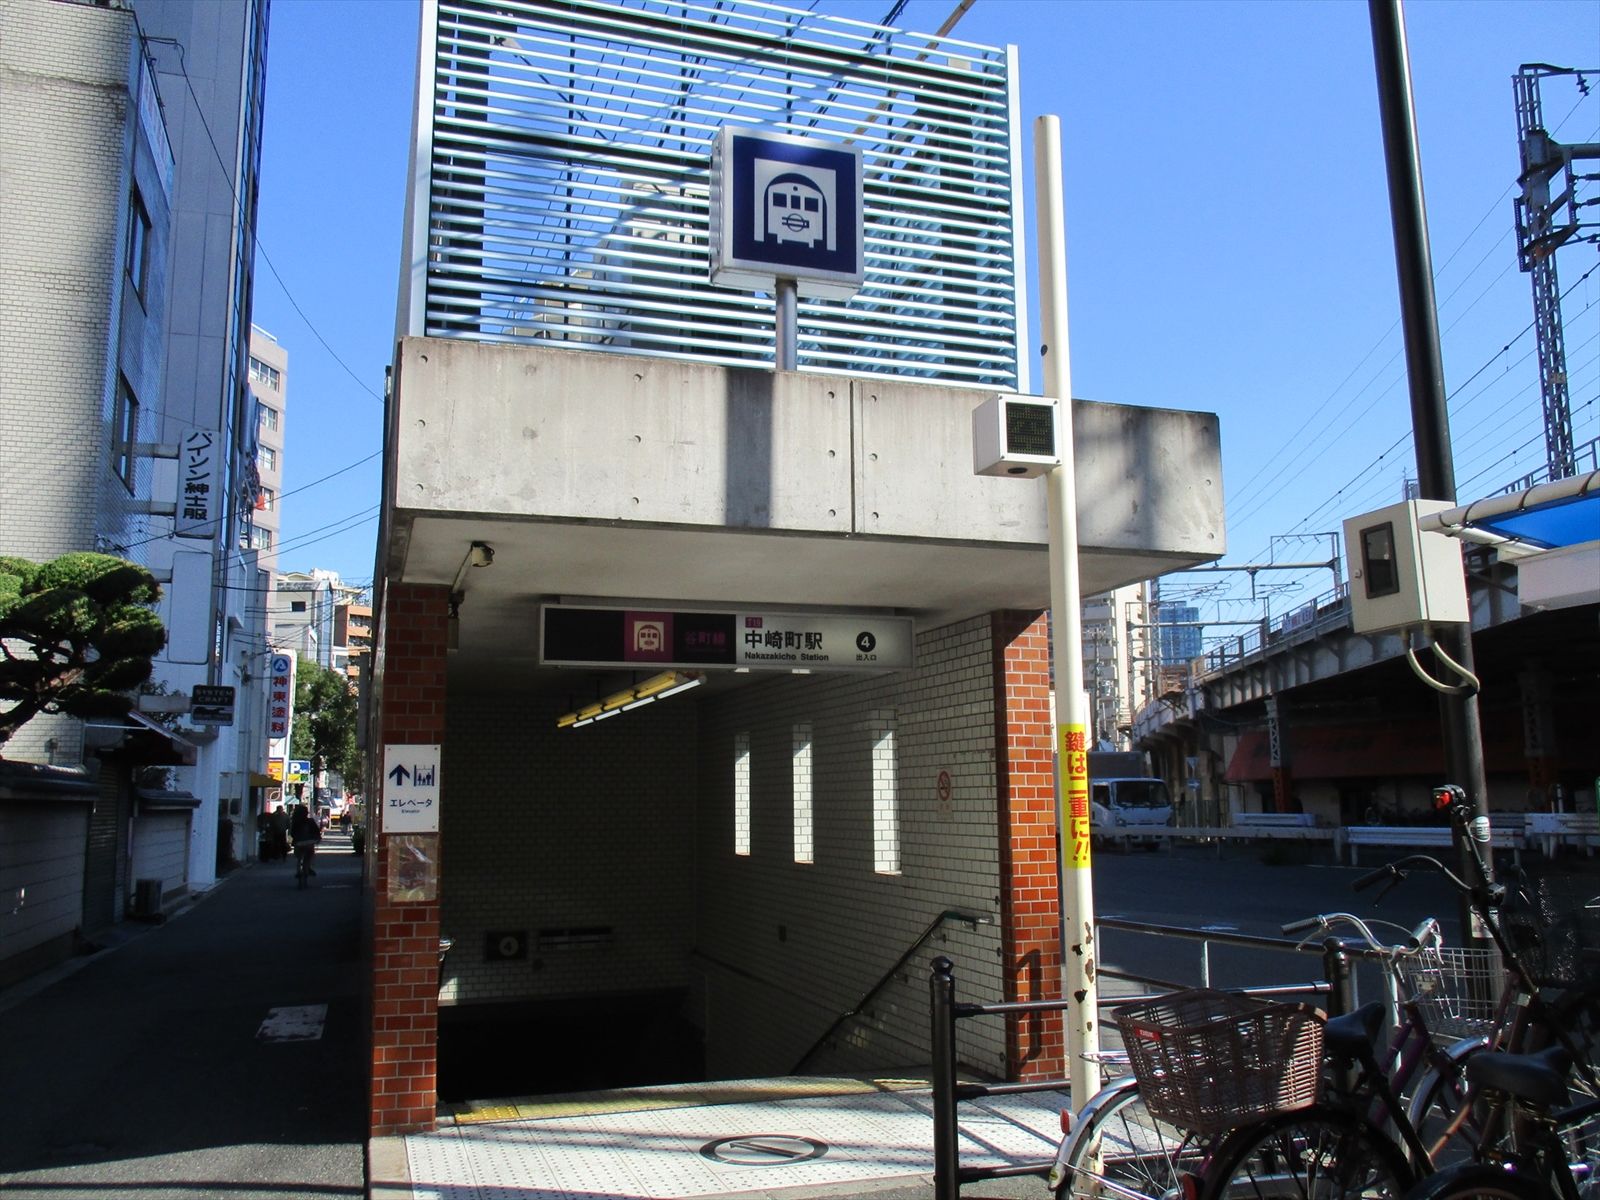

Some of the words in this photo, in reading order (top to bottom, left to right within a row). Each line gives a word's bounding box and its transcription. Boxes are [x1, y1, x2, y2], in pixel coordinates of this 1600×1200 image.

[183, 431, 212, 521] パイソン紳士服
[745, 630, 823, 650] 中崎町駅
[745, 651, 797, 661] Nakazakicho
[800, 653, 829, 661] Station
[856, 653, 877, 662] 出入口
[271, 675, 288, 734] 神東塗料
[290, 762, 301, 774] P
[389, 798, 433, 808] エレベータ
